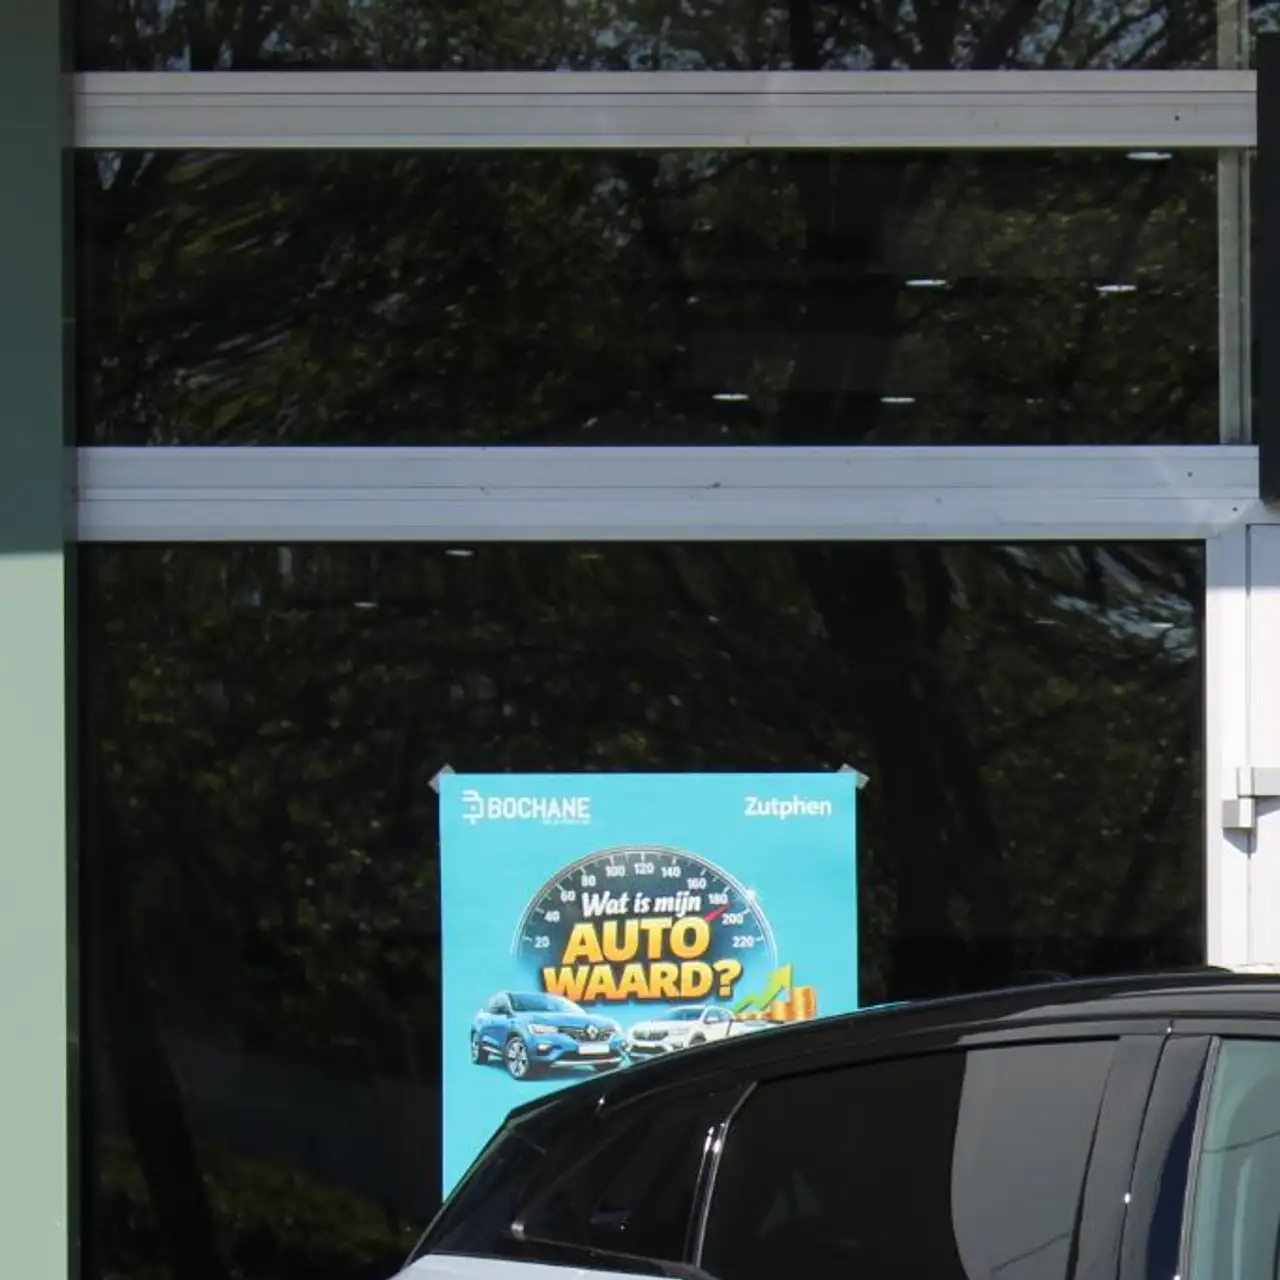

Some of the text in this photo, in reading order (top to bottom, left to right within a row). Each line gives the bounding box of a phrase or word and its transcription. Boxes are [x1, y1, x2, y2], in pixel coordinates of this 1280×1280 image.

[487, 796, 591, 819] BOCHANE
[743, 794, 832, 820] Zutphen
[605, 867, 626, 877] 100
[634, 863, 654, 874] 120
[661, 866, 681, 878] 140
[581, 891, 701, 918] Wat is mijn
[544, 911, 560, 922] 40
[722, 913, 743, 925] 200
[534, 936, 550, 948] 20
[562, 916, 711, 964] AUTO
[732, 936, 754, 948] 220
[542, 959, 742, 1001] WAARD?
